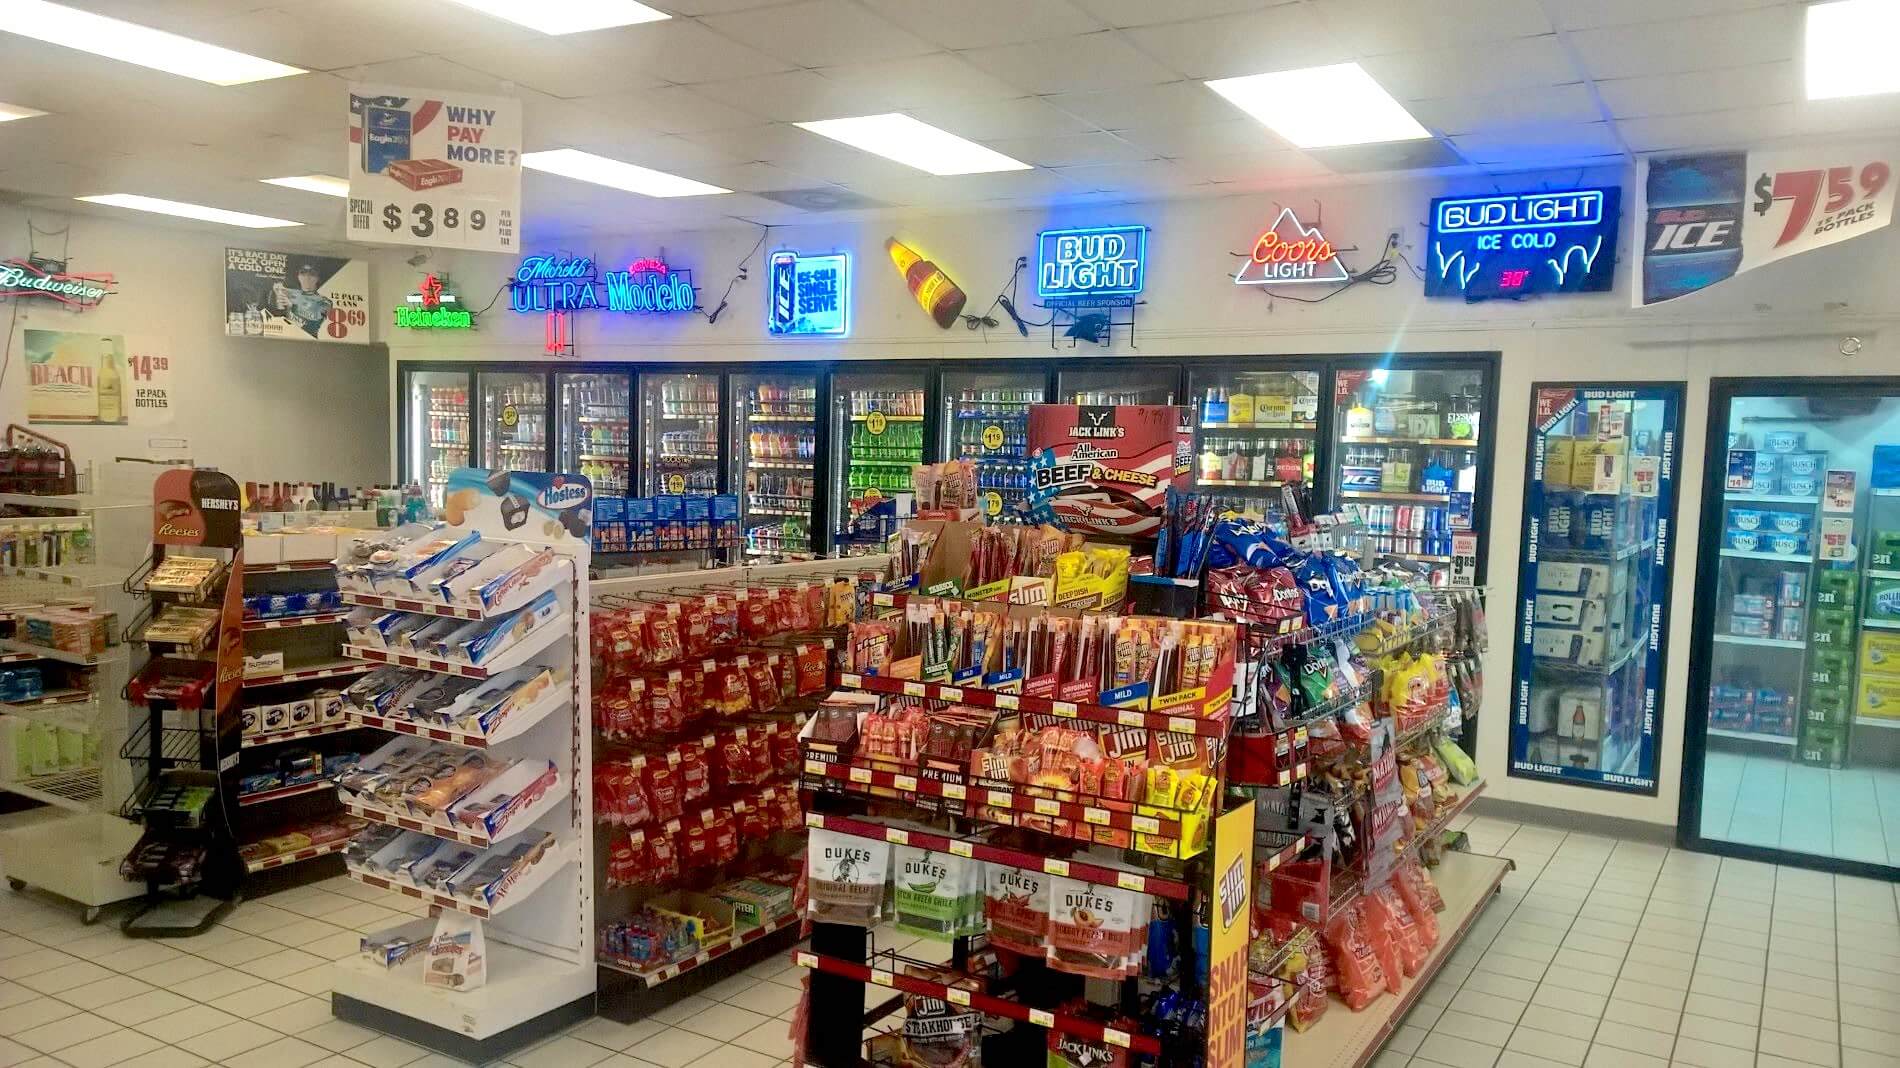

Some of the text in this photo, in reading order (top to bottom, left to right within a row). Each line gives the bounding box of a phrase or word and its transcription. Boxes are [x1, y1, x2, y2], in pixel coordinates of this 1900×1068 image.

[447, 105, 496, 126] WHY
[447, 125, 485, 143] PAY
[447, 144, 518, 166] MORE?
[350, 199, 373, 215] SPECIAL
[1446, 196, 1597, 227] BUD LIGHT
[1837, 202, 1874, 219] PACK
[1814, 210, 1875, 235] BOTTLES
[1477, 233, 1557, 249] ICE COLD
[1652, 219, 1736, 251] ICE
[249, 251, 268, 260] RACE
[1057, 234, 1126, 262] BUD
[1253, 231, 1337, 265] Coors
[228, 256, 286, 268] CRACK OPEN
[238, 264, 262, 272] COLD
[1264, 261, 1316, 278] LIGHT
[0, 265, 108, 299] Budweiser
[797, 268, 837, 283] ICE-COLD
[1043, 260, 1138, 289] LIGHT
[512, 281, 599, 312] ULTRA
[606, 271, 694, 311] Modelo
[776, 267, 792, 322] ICE
[798, 280, 837, 297] SINGLE
[341, 293, 363, 302] PACK
[798, 295, 837, 315] SERVE
[1097, 298, 1131, 306] SPONSOR
[396, 305, 471, 328] Heineken
[31, 365, 93, 389] BEACH
[147, 389, 167, 398] PACK
[1584, 390, 1636, 398] BUD LIGHT
[135, 398, 168, 408] BOTTLES
[1540, 397, 1579, 433] BUD LIGHT
[1068, 426, 1126, 438] JACK LINK'S
[1072, 449, 1118, 459] American
[1077, 444, 1090, 452] All
[1662, 432, 1673, 480] BUD LIGHT
[1175, 456, 1192, 467] BEEF
[1535, 435, 1545, 480] BUD LIGHT
[1037, 465, 1092, 487] BEEF
[1092, 468, 1102, 479] &
[1104, 468, 1158, 487] CHEESE
[1341, 475, 1381, 485] ICE
[1425, 479, 1445, 487] BUD
[545, 486, 586, 505] Hostess
[1421, 485, 1449, 493] LIGHT
[201, 497, 239, 510] HERSHEY'S
[1736, 514, 1760, 525] BUSCH
[1529, 517, 1539, 563] BUD LIGHT
[1656, 518, 1667, 566] BUD LIGHT
[1733, 536, 1758, 546] BUSCH
[966, 587, 993, 598] MONSTER
[1058, 587, 1088, 600] DEEP DISH
[1524, 599, 1534, 644] BUD LIGHT
[1649, 604, 1660, 652] BUD LIGHT
[962, 669, 974, 677] MILD
[999, 672, 1013, 681] MILD
[1026, 678, 1056, 690] ORIGINAL
[1062, 681, 1093, 694] ORIGINAL
[1114, 689, 1132, 700] MILD
[1159, 692, 1197, 705] TWIN PACK
[1519, 680, 1529, 725] BUD LIGHT
[1644, 688, 1654, 736] BUD LIGHT
[1165, 741, 1195, 763] Jim
[1514, 761, 1563, 775] BUD LIGHT
[1603, 773, 1654, 788] BUD LIGHT
[825, 847, 871, 862] DUKE'S
[905, 862, 947, 879] DUKE'S
[1000, 873, 1038, 893] DUKE'S
[1066, 895, 1113, 912] DUKE'S
[1210, 943, 1248, 1004] SNAP
[1210, 993, 1236, 1037] INTO
[1058, 1038, 1114, 1062] JACK LINK'S
